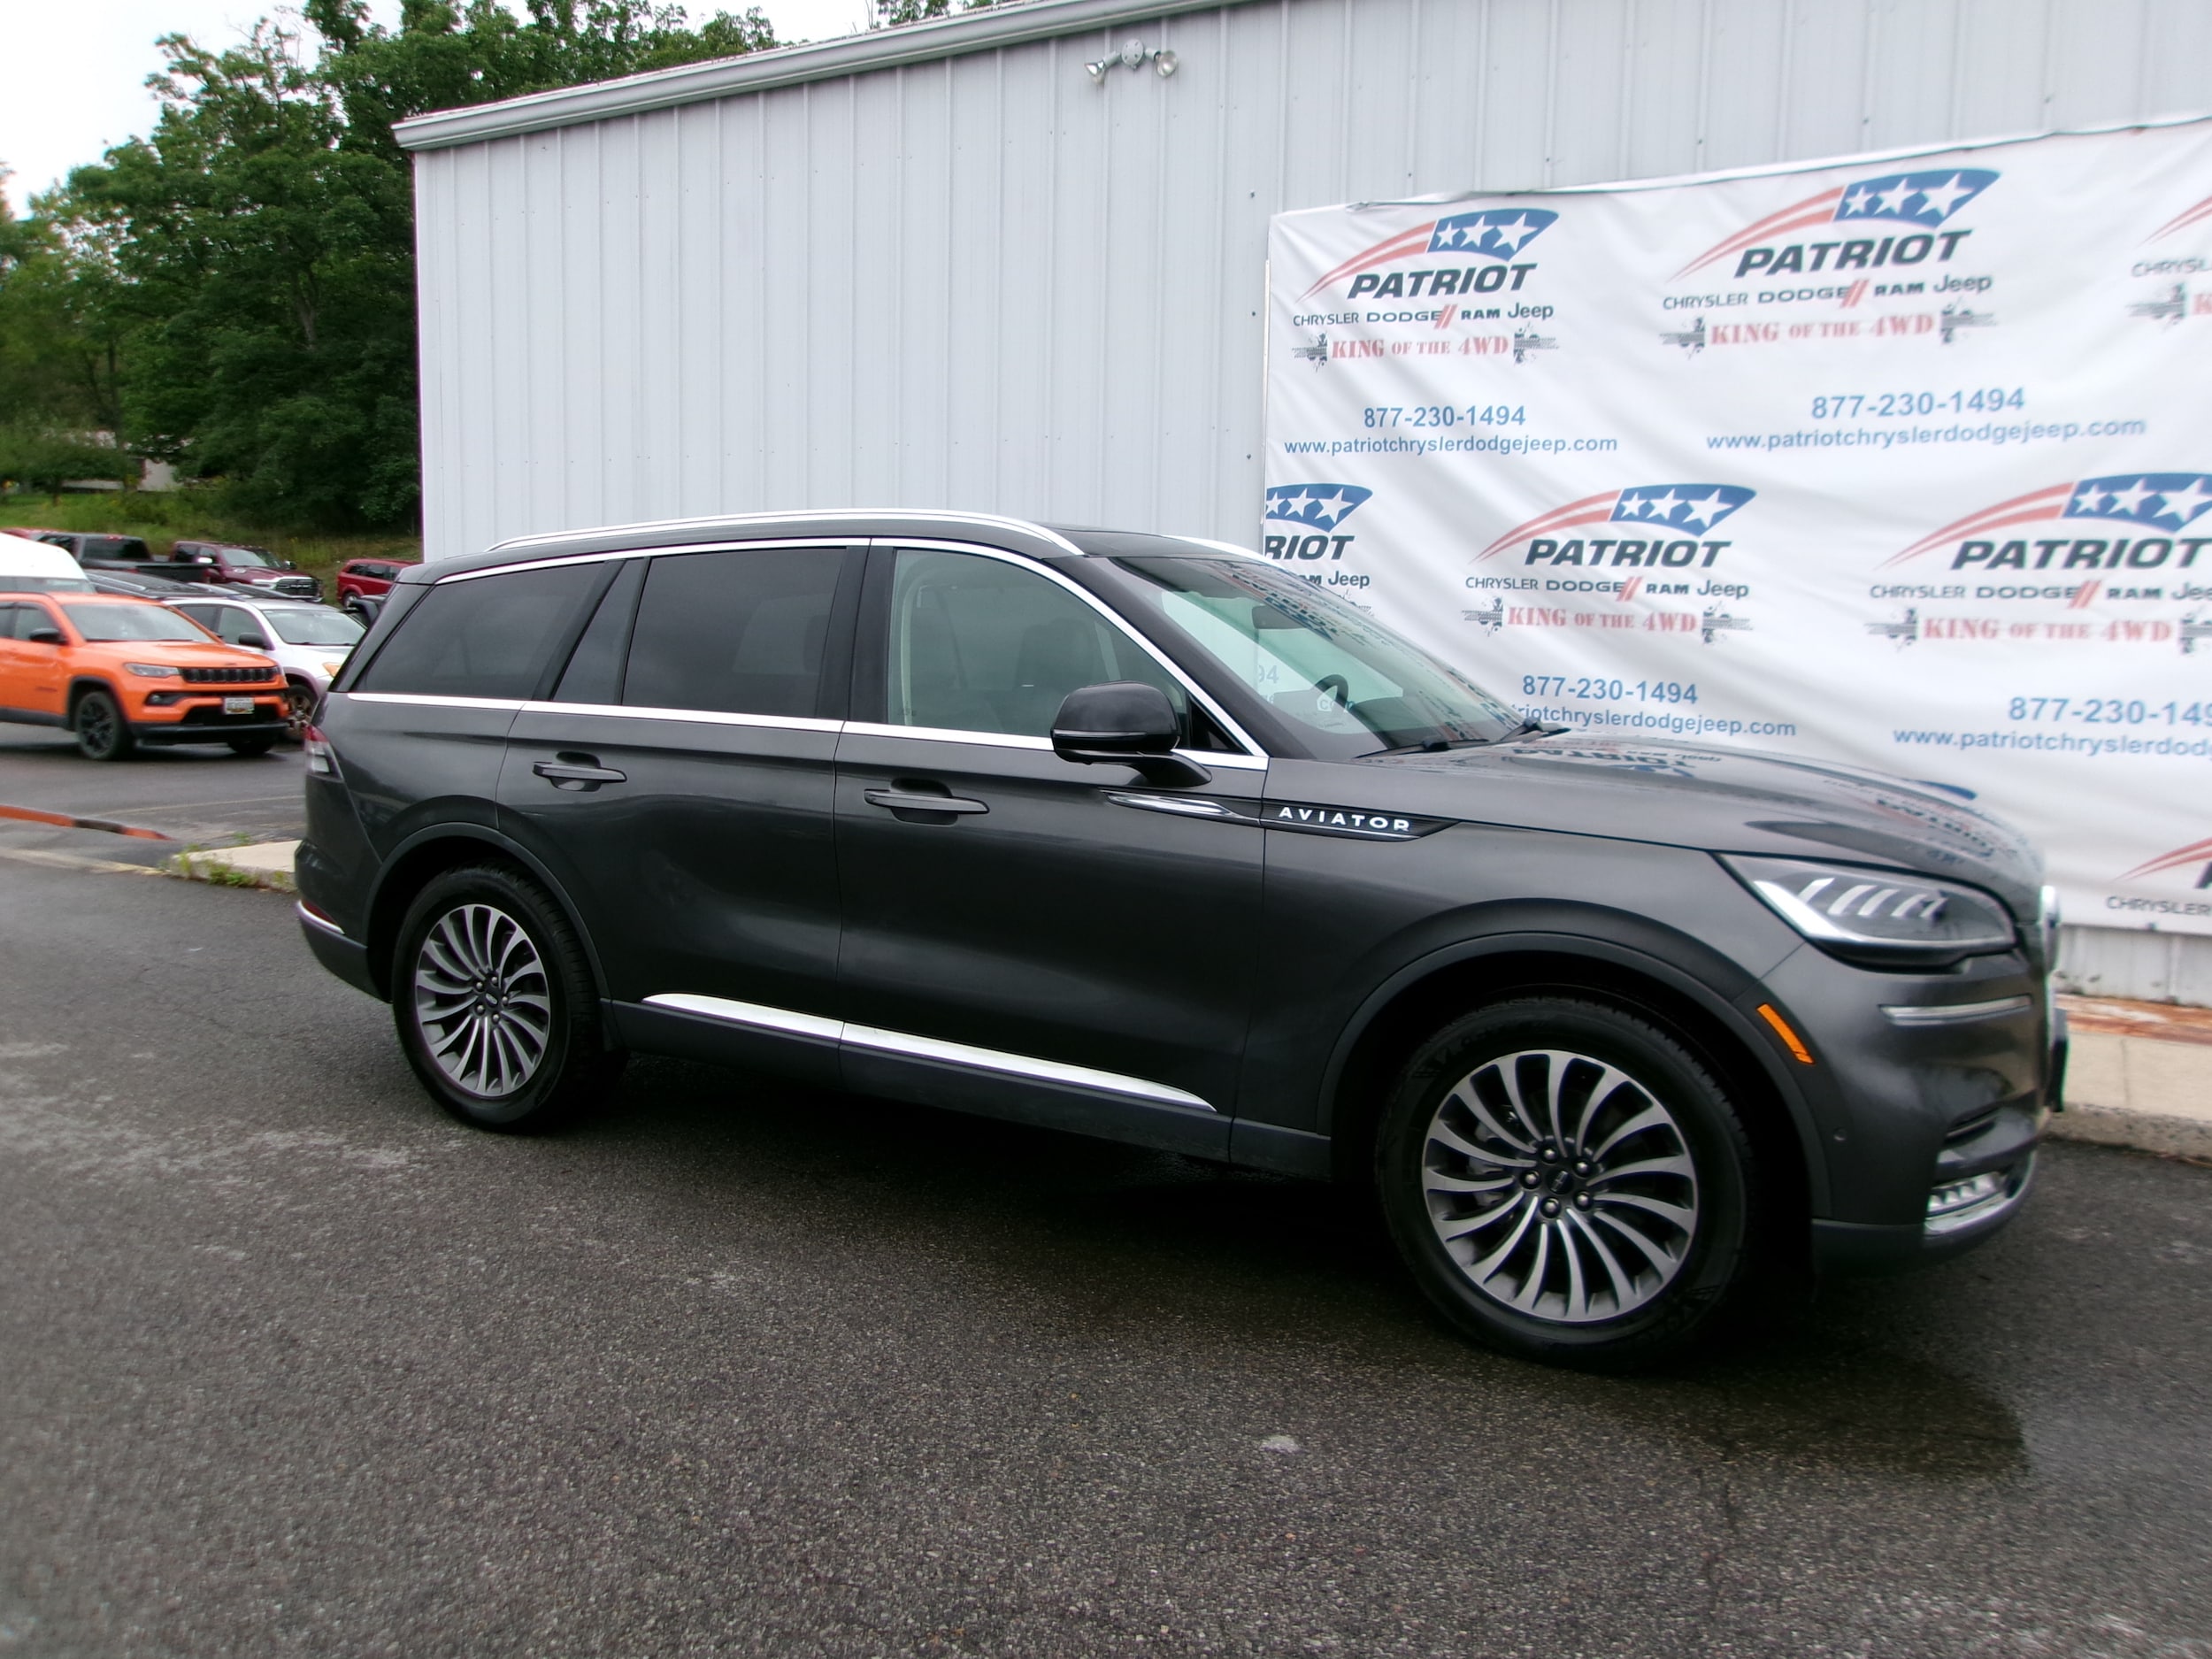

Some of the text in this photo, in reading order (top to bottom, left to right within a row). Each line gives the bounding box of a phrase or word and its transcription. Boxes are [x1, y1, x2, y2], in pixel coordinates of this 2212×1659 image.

[1734, 229, 1973, 279] PATRIOT
[1348, 263, 1538, 300] PATRIOT
[1663, 273, 1993, 311] CHRYSLER DODGE RAM Jeep
[1293, 302, 1554, 326] CHRYSLER DODGE RAM Jeep
[1711, 313, 1934, 346] KING OF THE 4WD
[1332, 335, 1509, 359] KING OF THE 4WD
[1363, 404, 1526, 428] 877-230-1494
[1811, 387, 2024, 419] 877-230-1494
[1285, 434, 1618, 457] www.patriotchryslerdodgejeep.com
[1707, 418, 2146, 452] www.patriotchryslerdodgejeep.com
[1525, 538, 1732, 569] PATRIOT
[1950, 536, 2212, 571] PATRIOT
[1327, 570, 1371, 589] Jeep
[1465, 577, 1749, 600] CHRYSLER DODGE RAM Jeep
[1870, 584, 1966, 600] CHRYSLER
[1976, 585, 2080, 601] DODGE
[2106, 586, 2162, 601] RAM
[1508, 607, 1697, 633] KING OF THE 4WD
[1922, 617, 2172, 643] KING OF THE 4WD
[1522, 674, 1698, 704] 877-230-1494
[1279, 806, 1410, 832] AVIATOR
